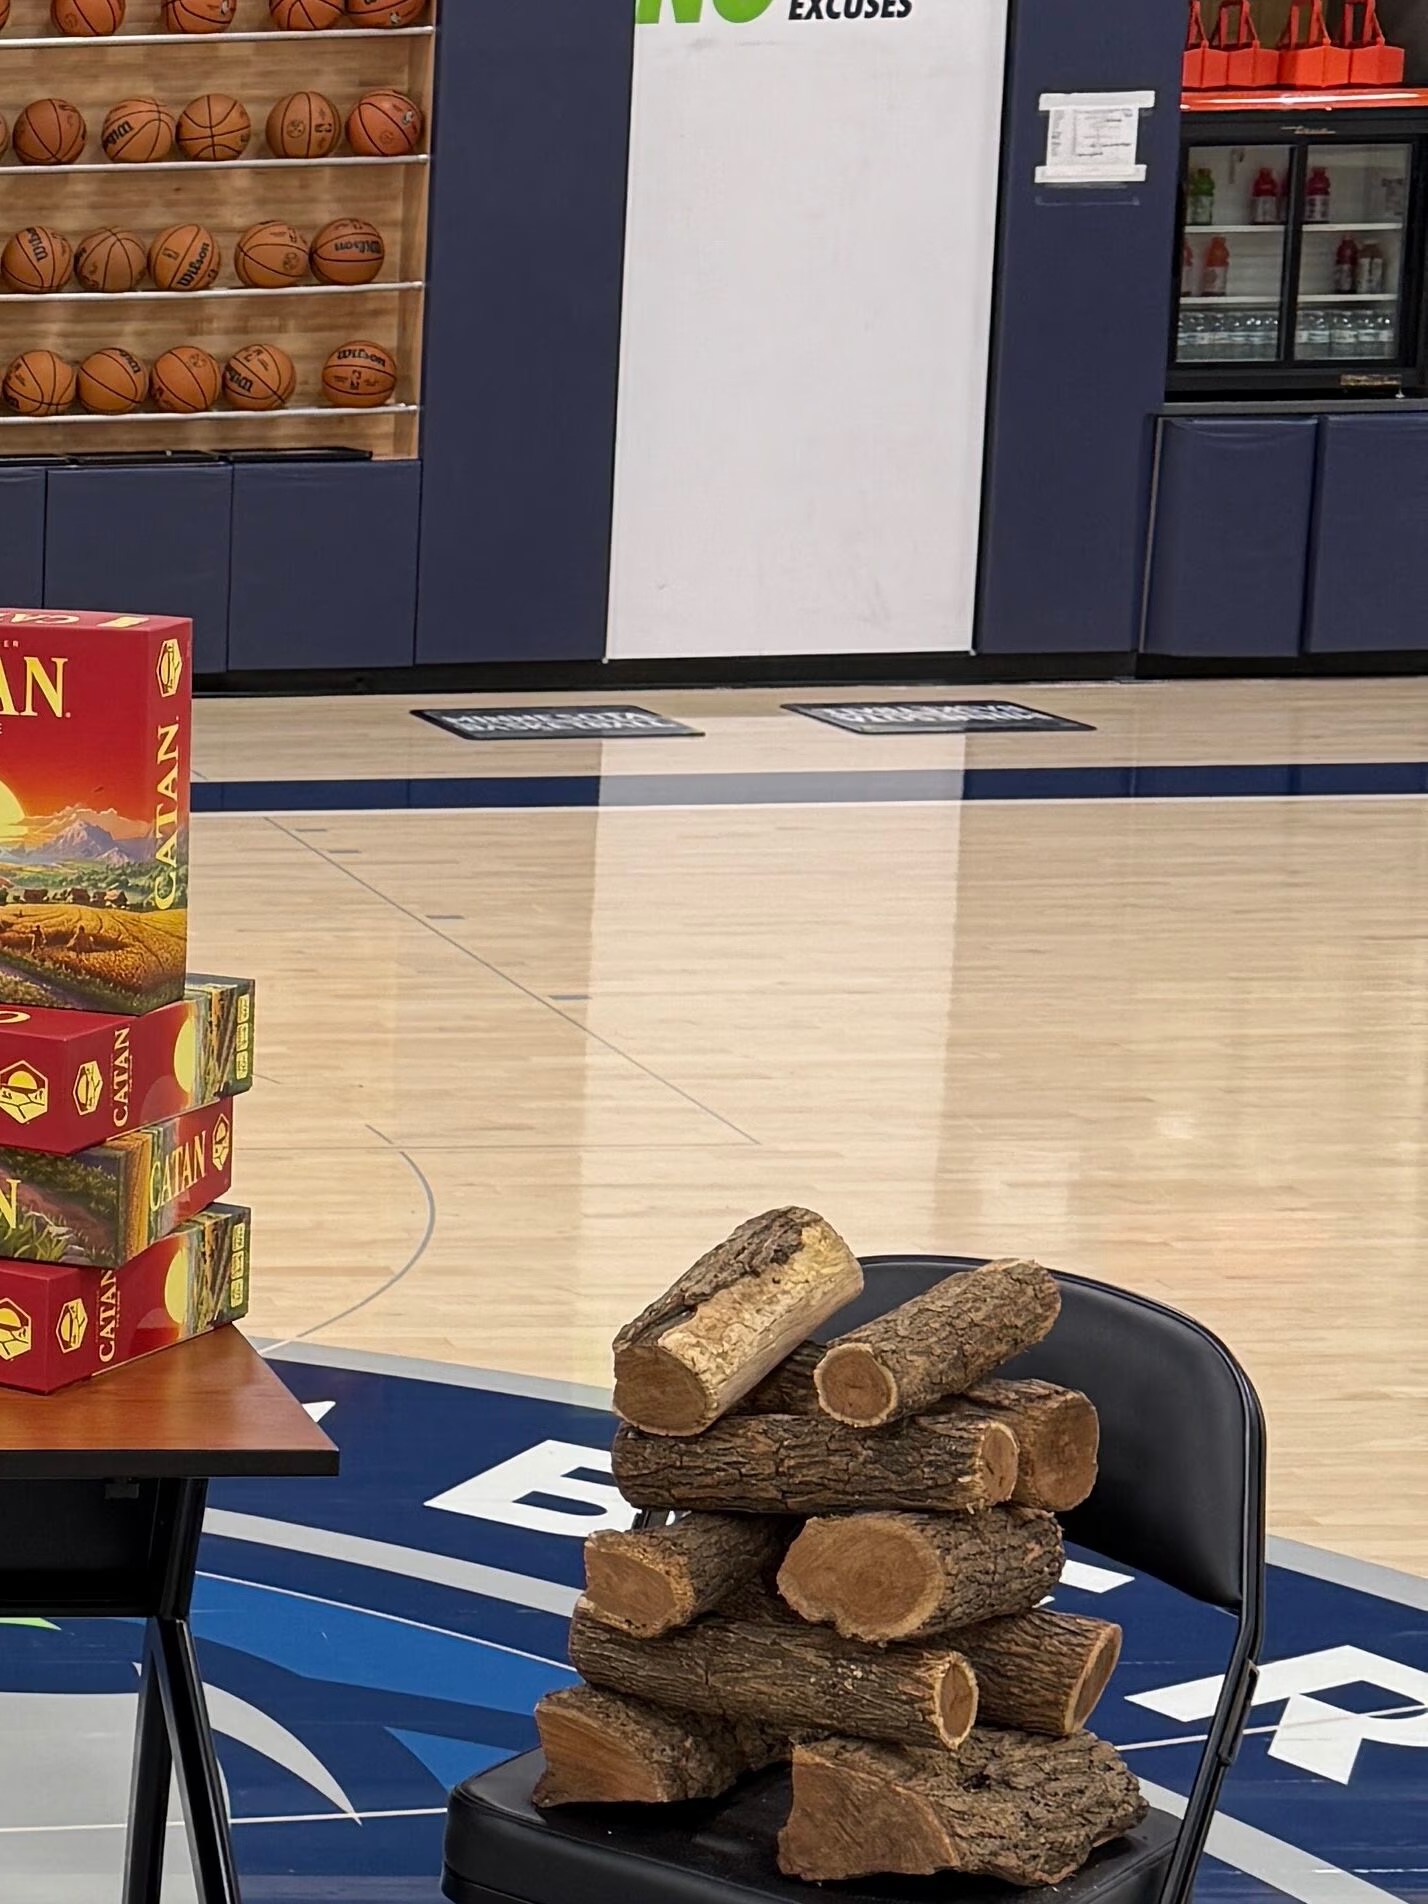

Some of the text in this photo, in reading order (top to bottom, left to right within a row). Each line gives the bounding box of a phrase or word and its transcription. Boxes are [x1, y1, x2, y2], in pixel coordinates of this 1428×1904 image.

[176, 242, 211, 287] Wilson
[337, 348, 386, 367] Wilson
[154, 718, 180, 910] CATAN
[111, 1026, 132, 1128] CATAN
[150, 1130, 207, 1212] CATAN
